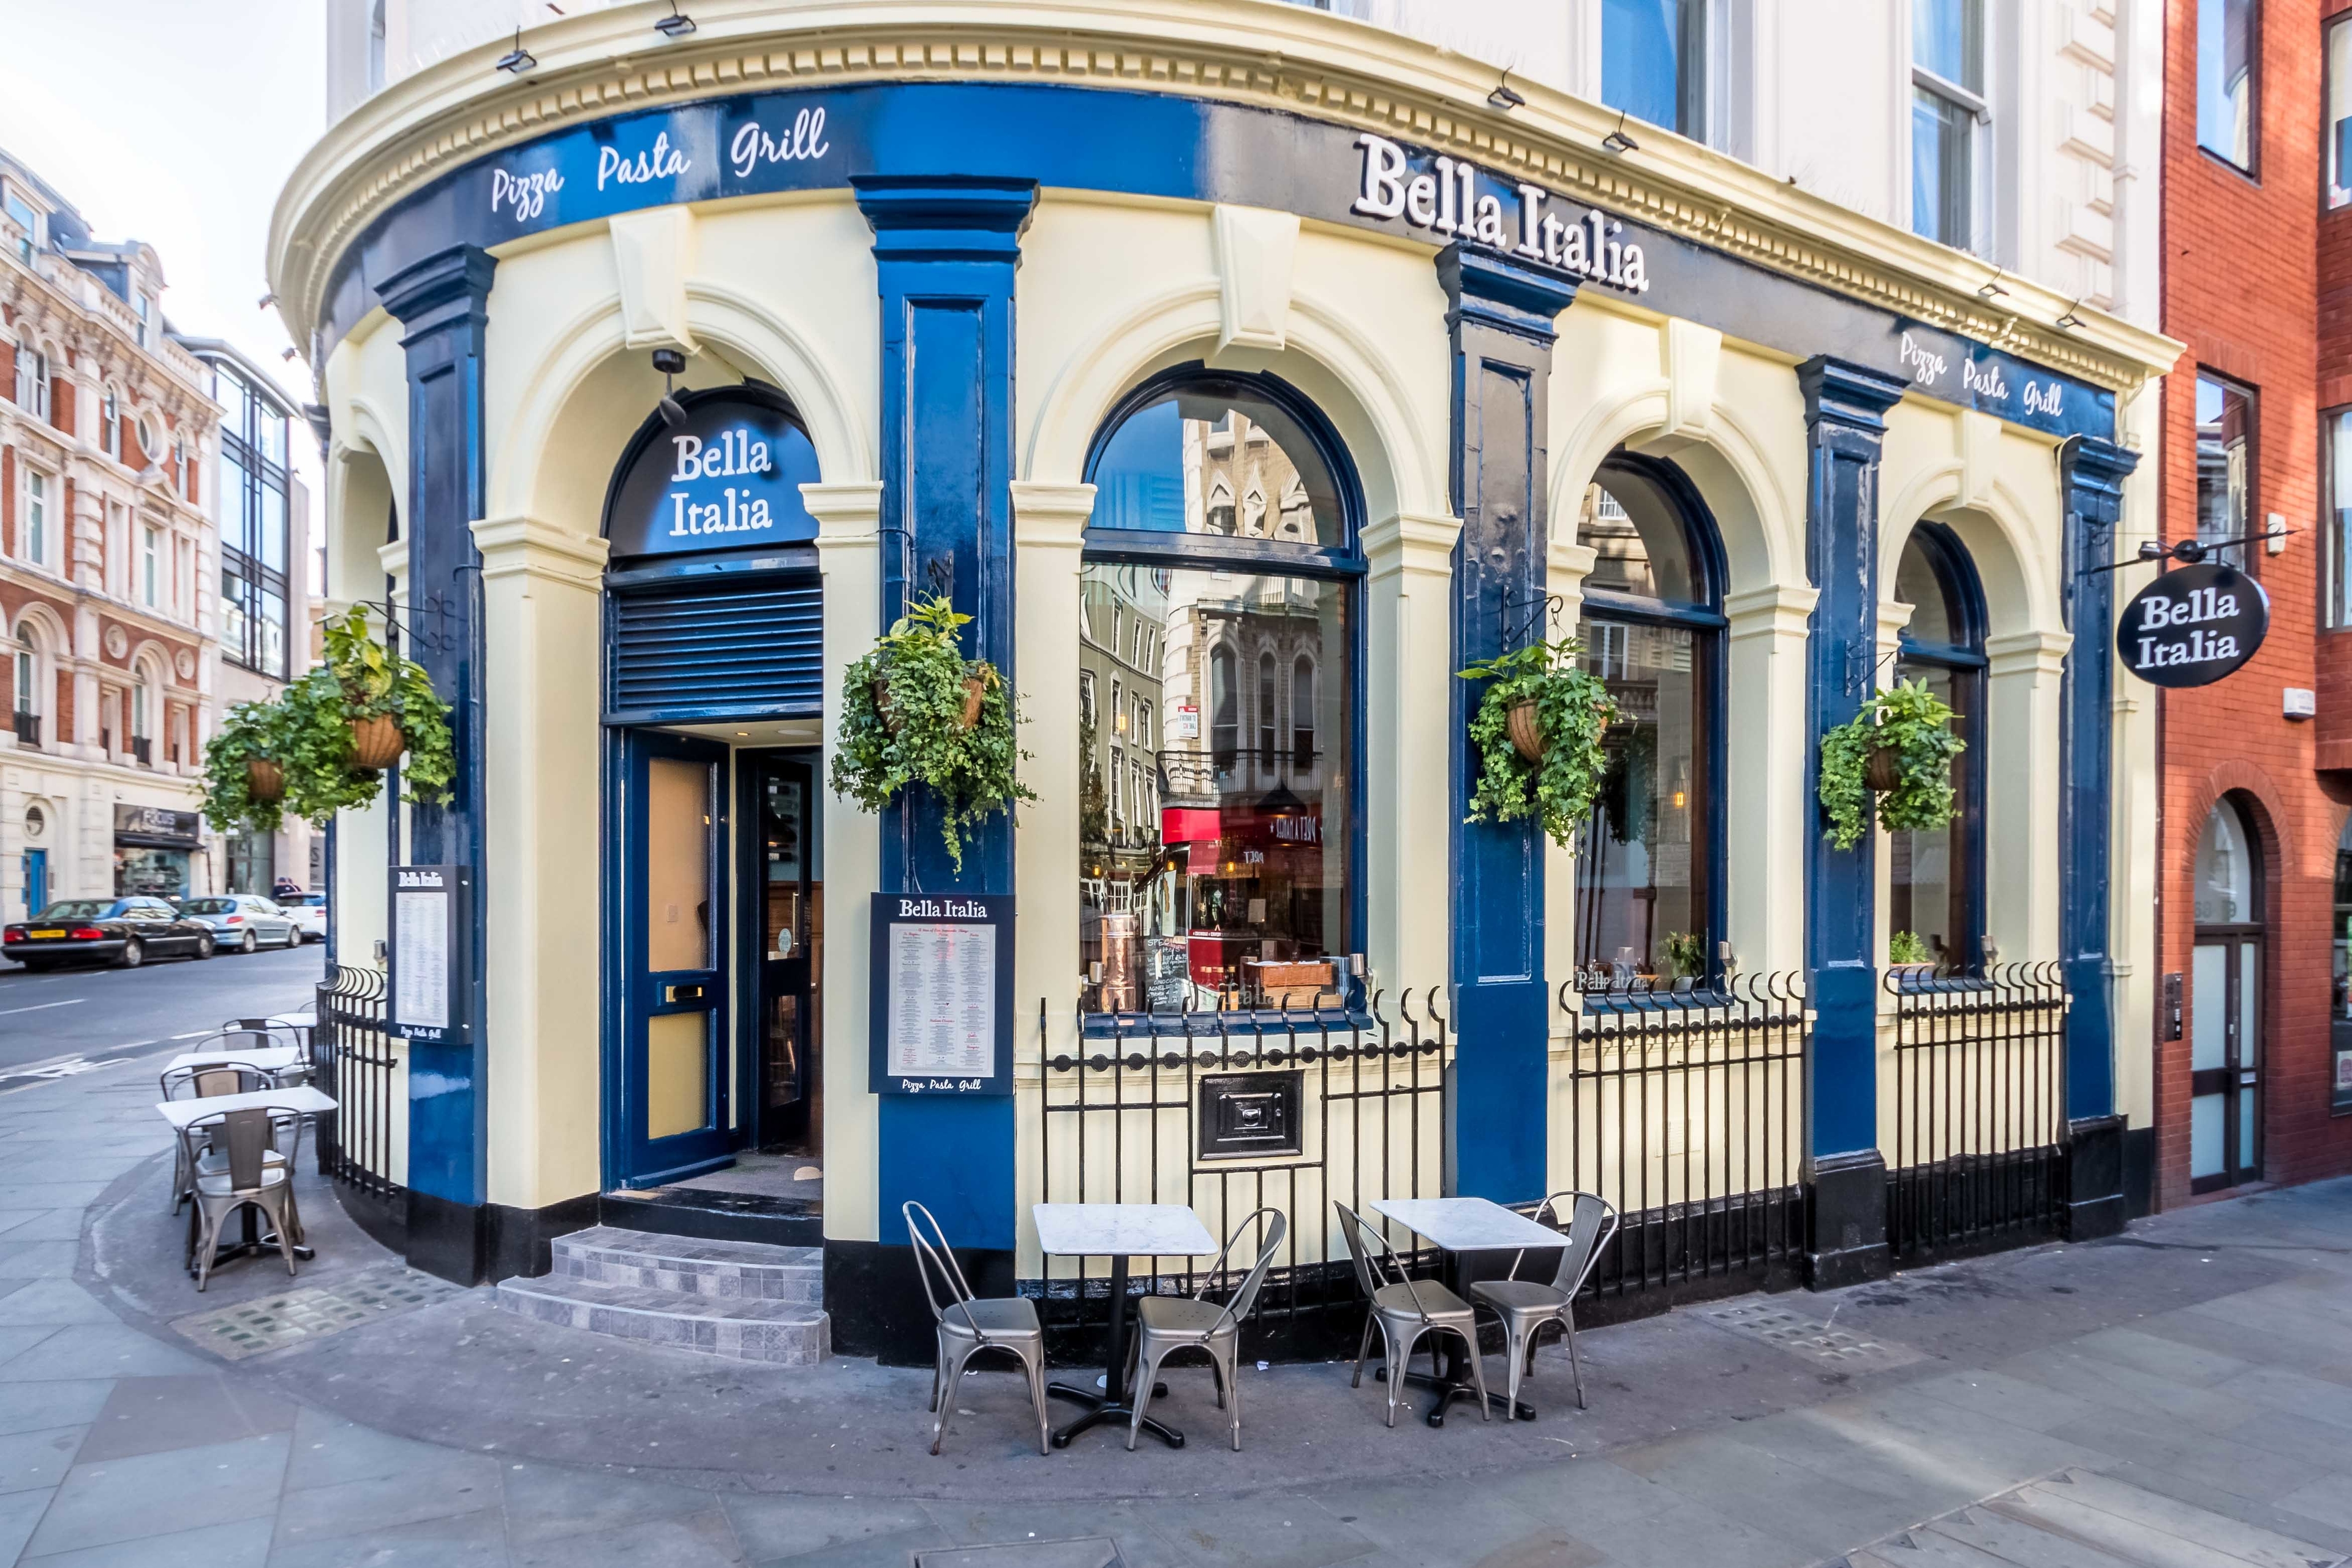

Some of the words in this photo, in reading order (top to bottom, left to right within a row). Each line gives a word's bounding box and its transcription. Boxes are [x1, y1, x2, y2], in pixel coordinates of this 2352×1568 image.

[492, 168, 564, 222] Pizza
[598, 131, 691, 191] Pasta
[731, 107, 829, 178] Grill
[1352, 132, 1507, 247] Bella
[1518, 183, 1649, 292] Italia
[1900, 331, 1947, 385] Pizza
[1963, 358, 2009, 399] Pasta
[2024, 380, 2063, 417] Grill
[671, 429, 771, 482] Bella
[669, 488, 772, 536] Italia
[2138, 587, 2240, 631] Bella
[2135, 630, 2240, 669] Italia
[899, 899, 941, 916] Bella
[943, 900, 987, 918] Italia
[902, 1079, 925, 1092] Pizza
[930, 1079, 954, 1090] Pasta
[959, 1079, 981, 1091] Grill
